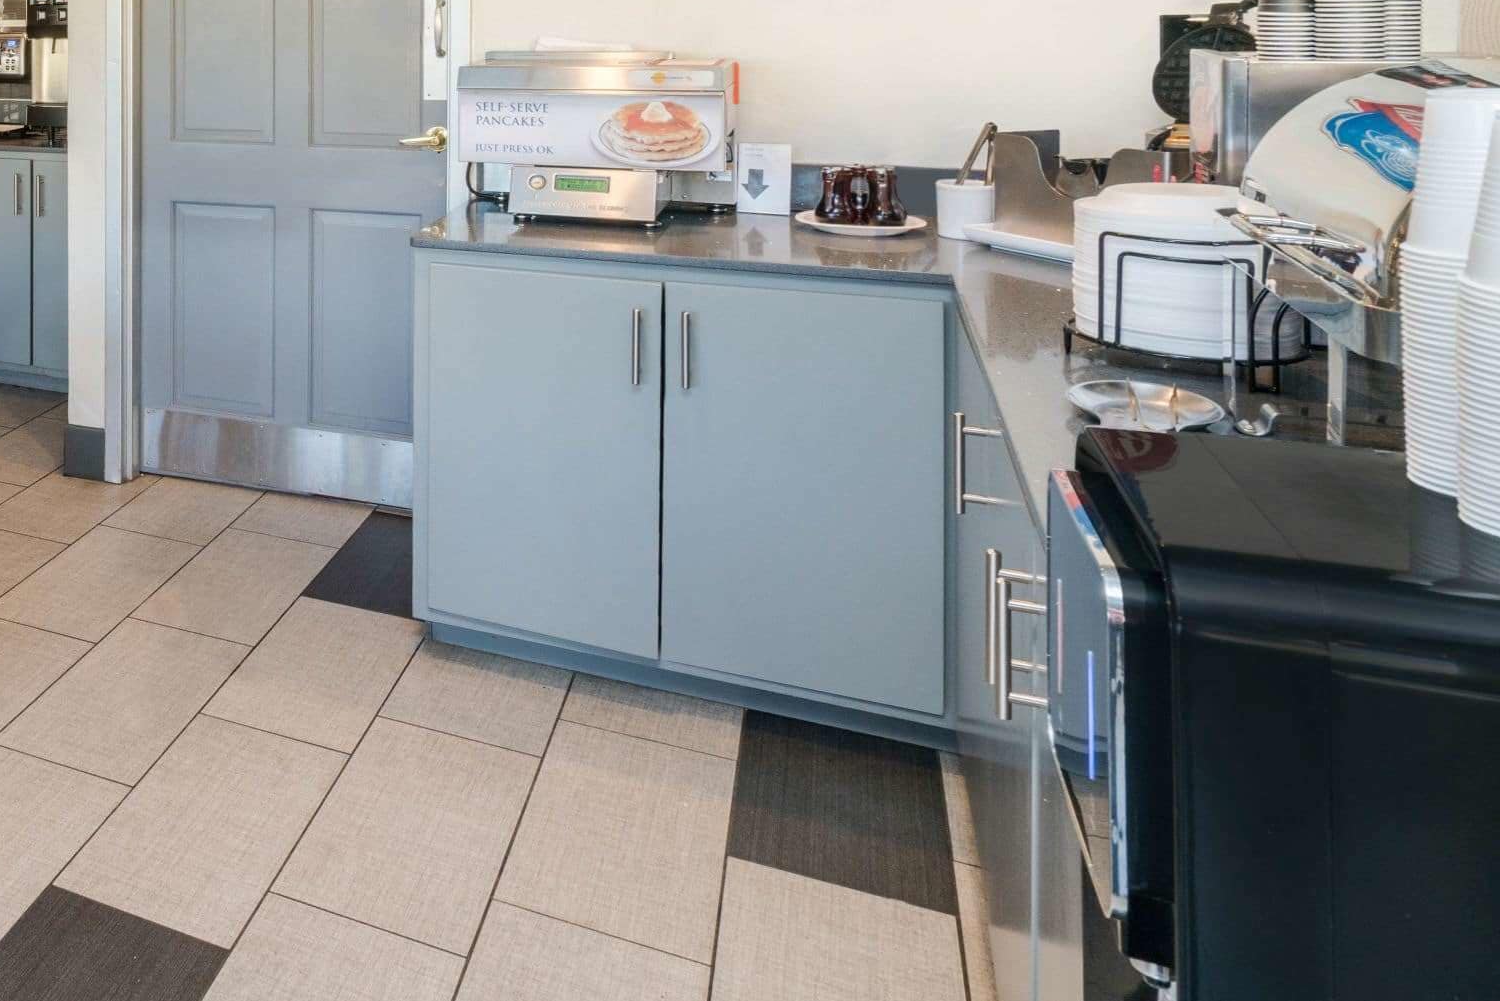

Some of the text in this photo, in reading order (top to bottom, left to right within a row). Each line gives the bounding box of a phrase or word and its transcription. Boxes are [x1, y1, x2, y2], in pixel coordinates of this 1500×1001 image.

[476, 102, 549, 113] SELF-SERVE
[476, 115, 545, 127] PANCAKES
[476, 143, 554, 155] JUST PRESS OK
